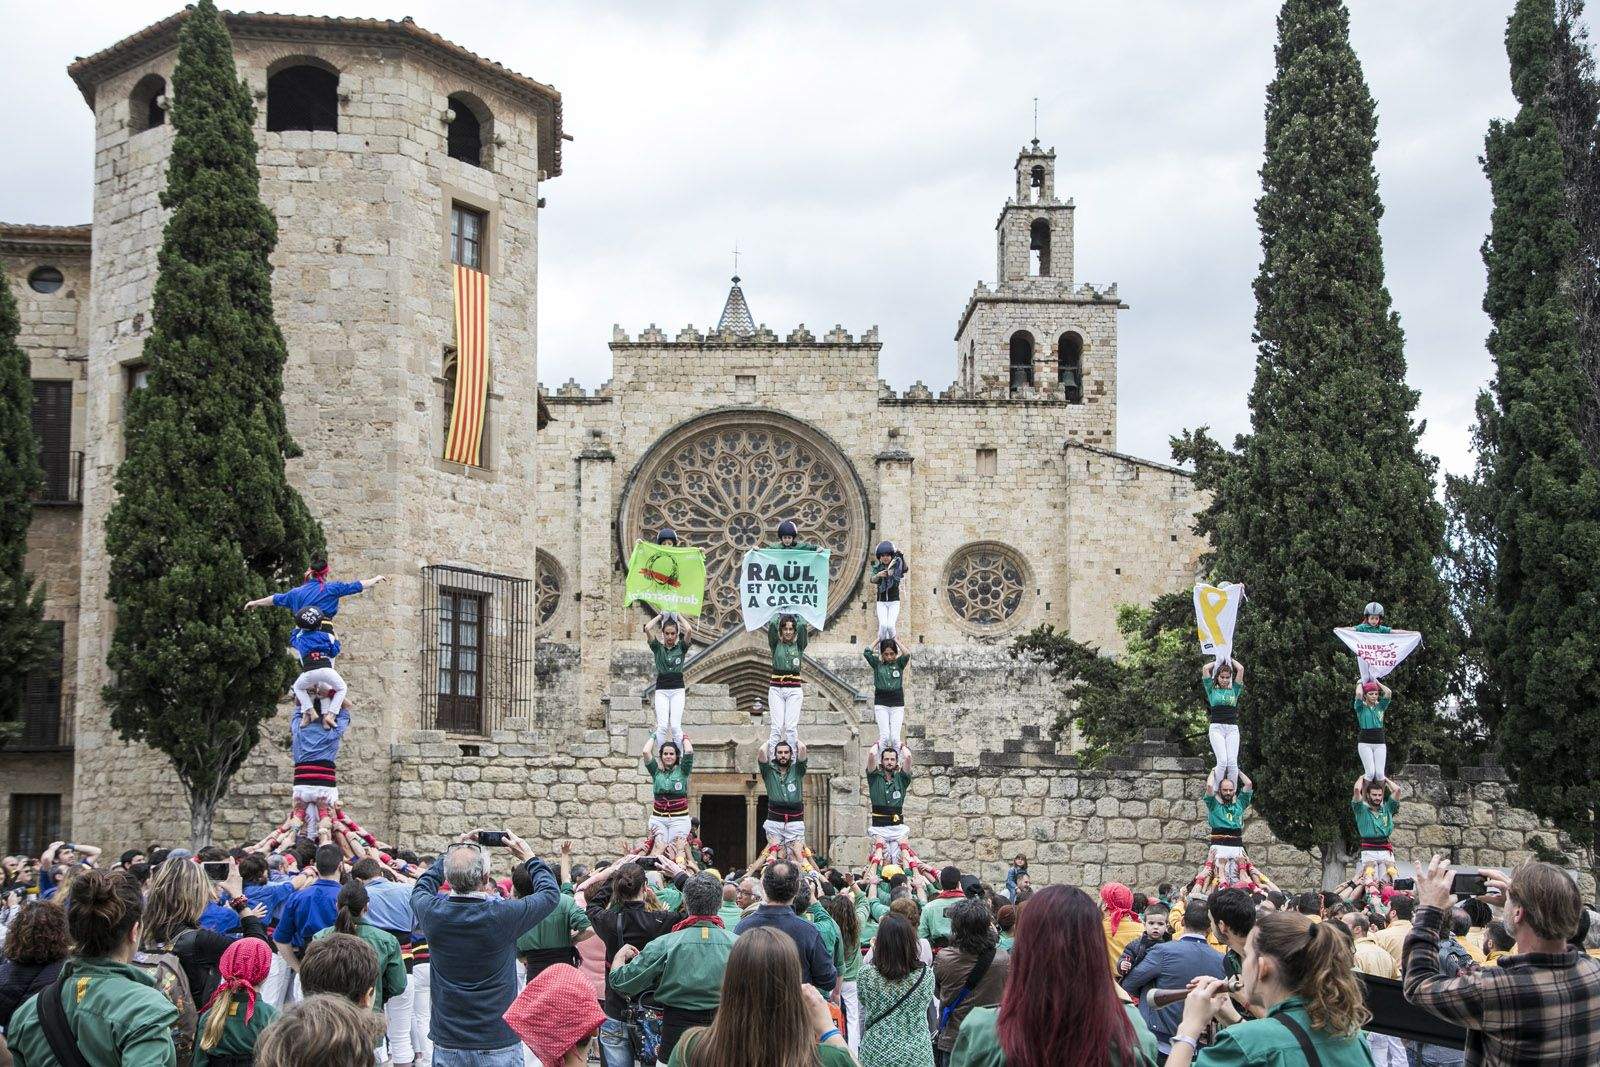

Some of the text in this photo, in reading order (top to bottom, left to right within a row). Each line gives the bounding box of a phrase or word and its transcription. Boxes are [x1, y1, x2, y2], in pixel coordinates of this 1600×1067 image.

[747, 561, 818, 583] RAÜL,
[747, 583, 818, 594] ET VOLEM
[748, 595, 818, 608] A CASA!
